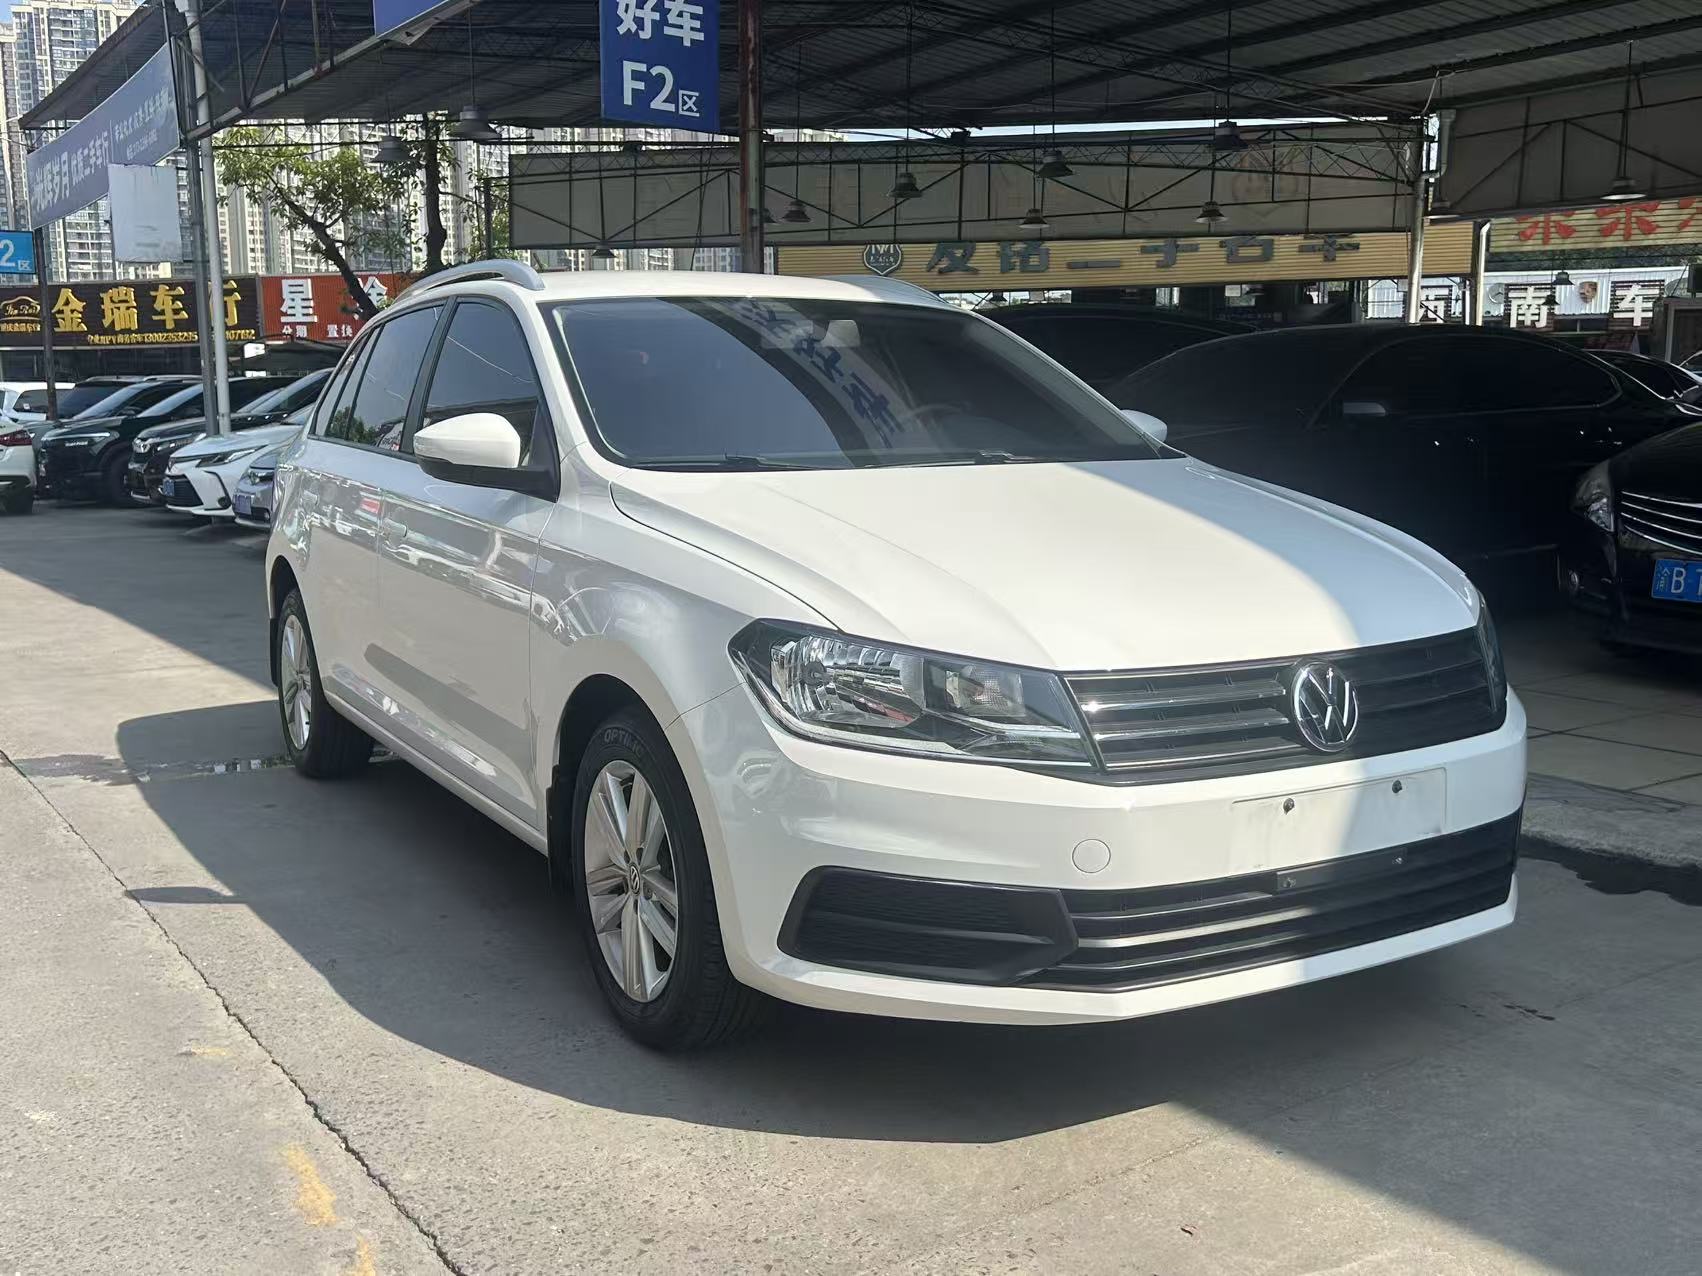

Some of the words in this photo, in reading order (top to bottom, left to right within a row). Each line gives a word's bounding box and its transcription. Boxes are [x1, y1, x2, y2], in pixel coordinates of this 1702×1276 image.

[616, 0, 704, 47] 好车
[622, 60, 700, 117] F2区
[51, 280, 241, 332] 金瑞车行
